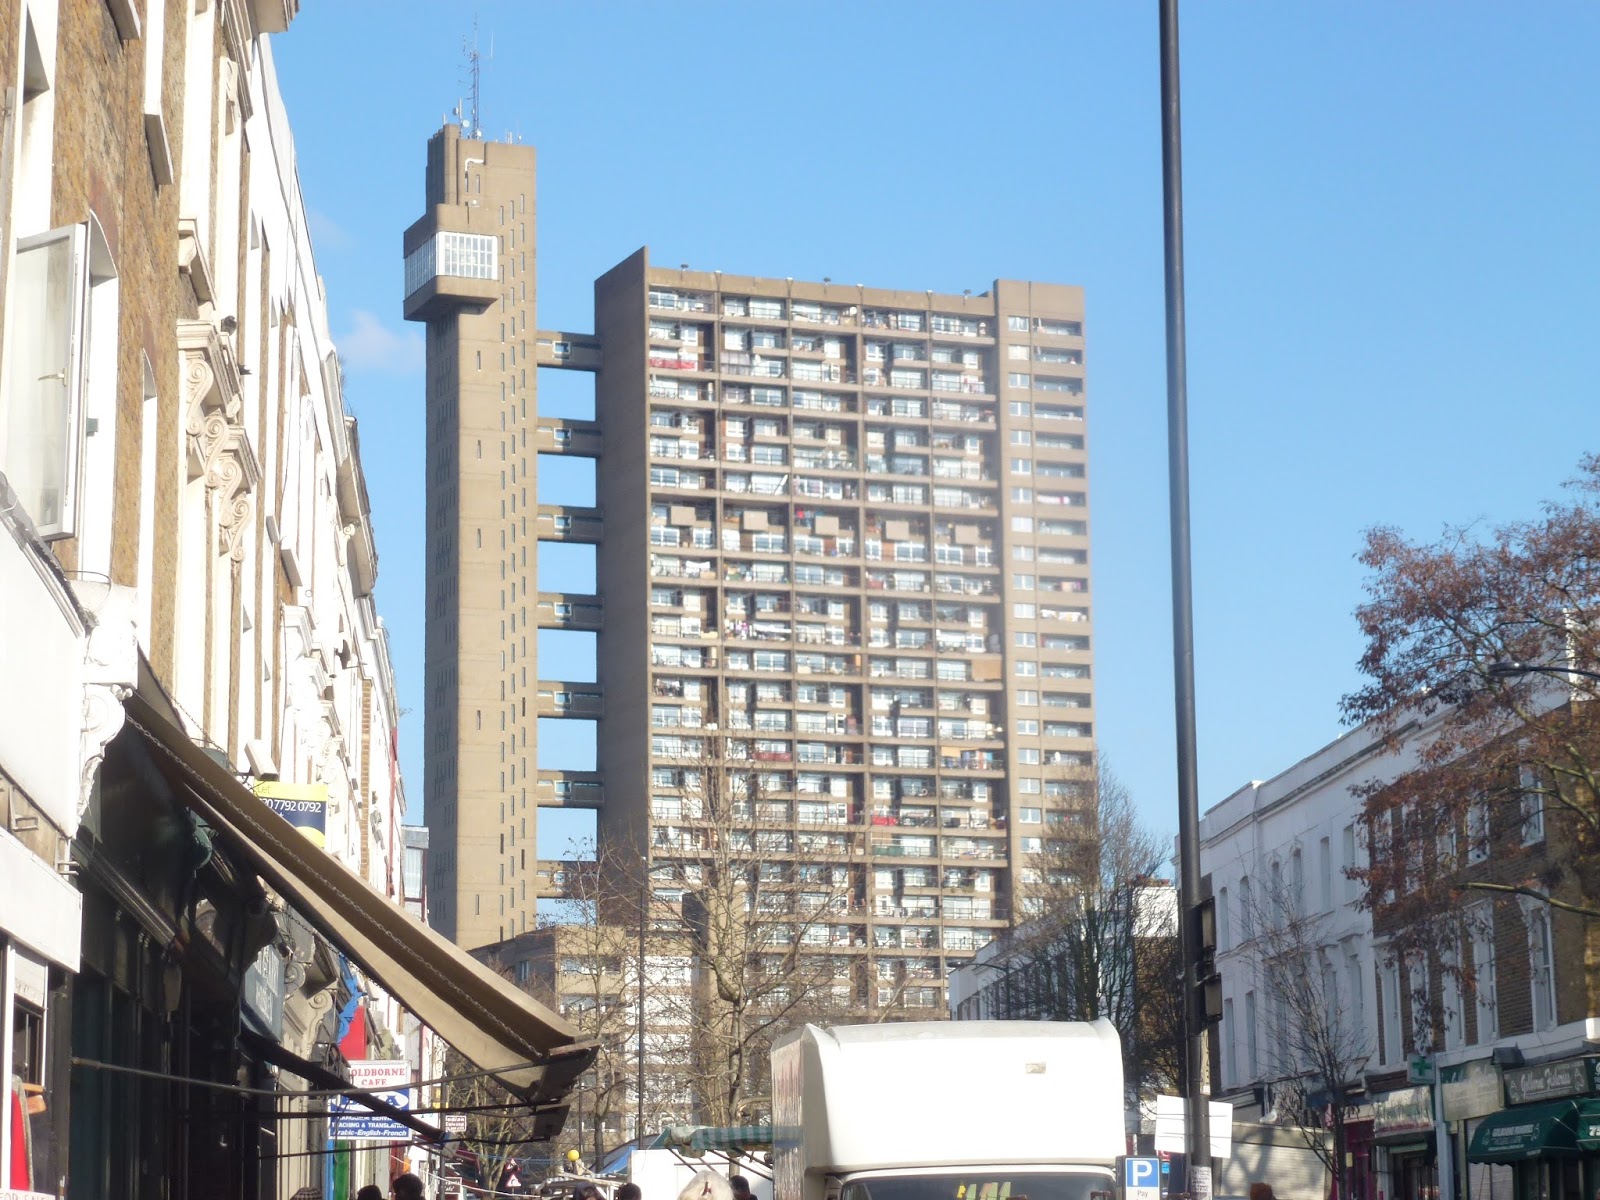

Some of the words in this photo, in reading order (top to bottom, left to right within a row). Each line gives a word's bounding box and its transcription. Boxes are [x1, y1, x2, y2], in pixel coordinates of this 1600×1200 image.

[259, 798, 273, 809] 20
[274, 799, 297, 811] 7792
[298, 801, 322, 813] 0792
[351, 1068, 405, 1077] OLDBORNE
[333, 1129, 407, 1137] rabic-English-French
[1132, 1160, 1152, 1186] P
